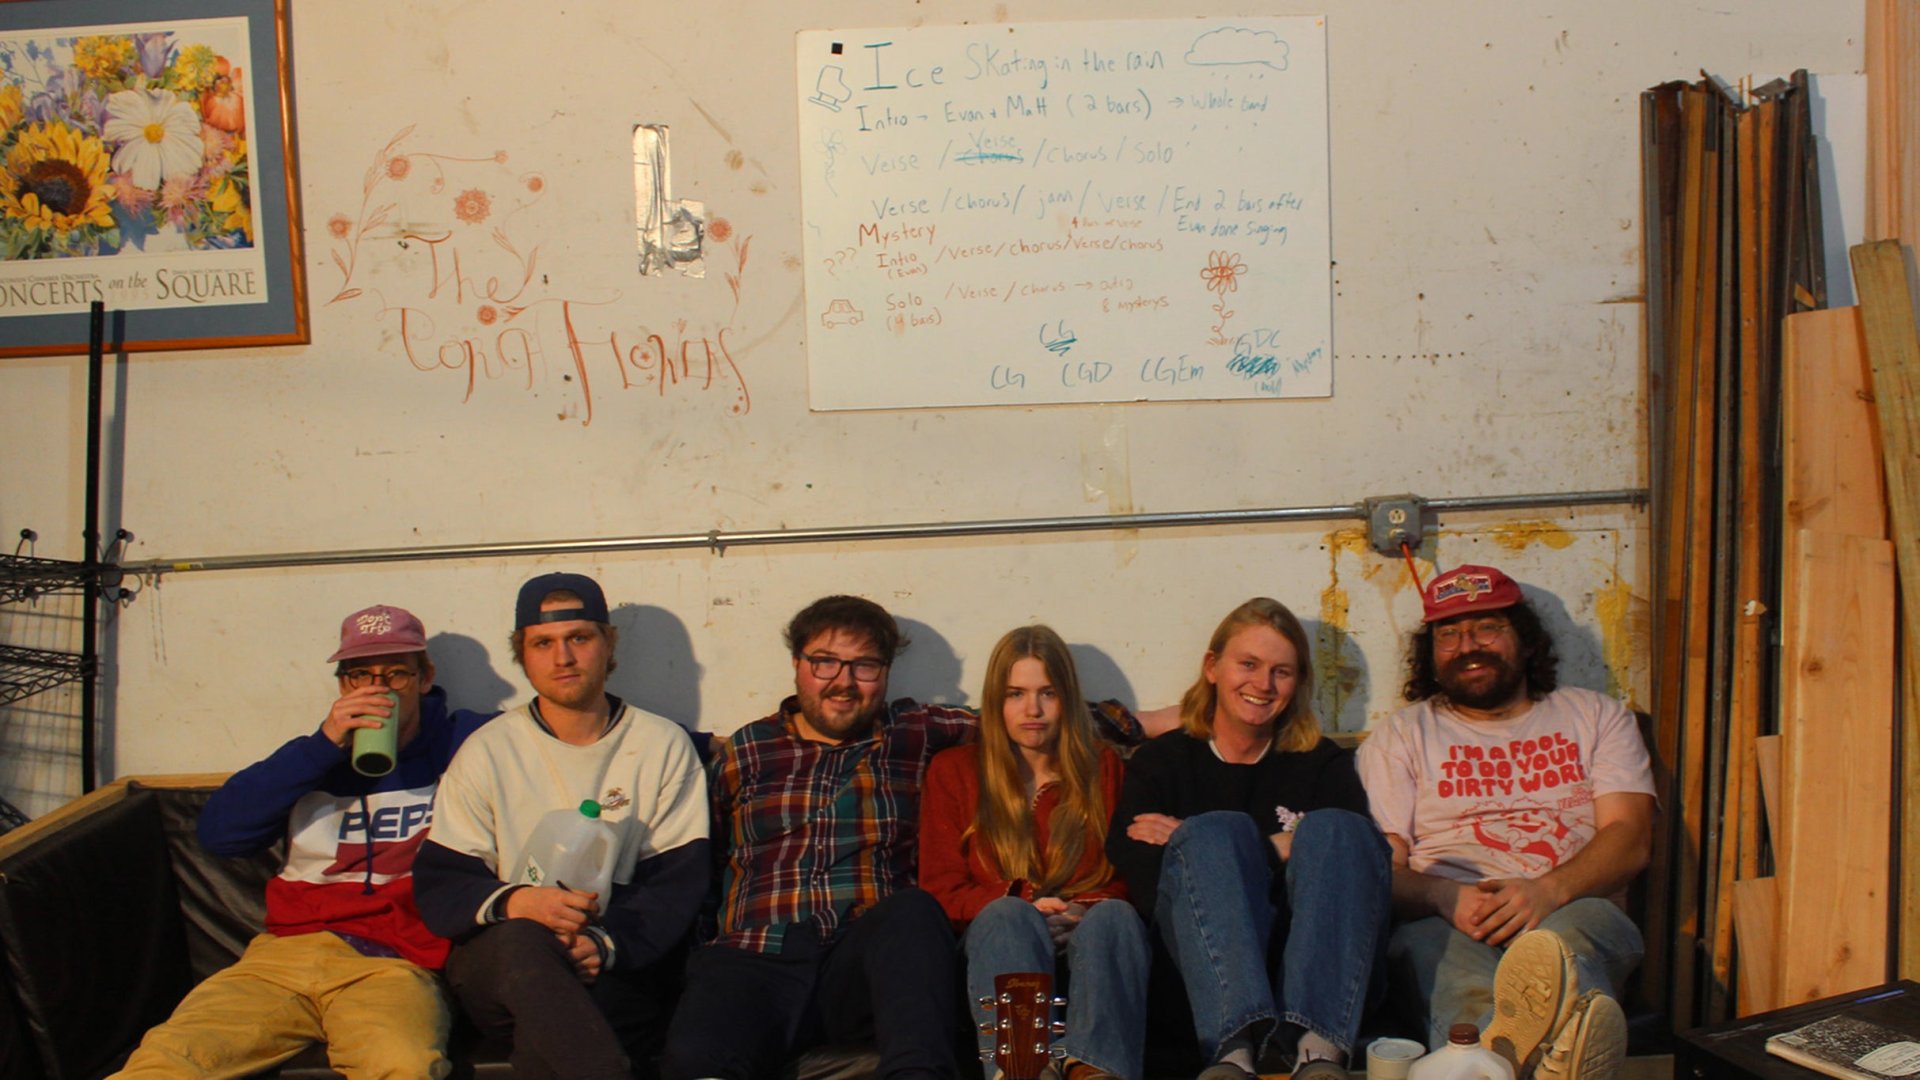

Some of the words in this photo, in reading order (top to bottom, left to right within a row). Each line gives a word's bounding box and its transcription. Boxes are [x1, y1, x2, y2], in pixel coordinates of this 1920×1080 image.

[864, 41, 944, 91] Ice
[1054, 55, 1071, 71] in
[1083, 48, 1115, 72] the
[1126, 50, 1164, 70] rain
[856, 104, 907, 132] Intro
[944, 101, 984, 123] Evan
[968, 128, 1016, 150] Verse
[861, 152, 920, 176] Verse
[1134, 141, 1173, 164] Solo
[872, 197, 930, 220] Verse
[1036, 189, 1073, 221] jam
[1173, 186, 1203, 212] End
[1268, 191, 1304, 211] after
[858, 222, 936, 249] Mystery
[1177, 214, 1206, 233] Evan
[1210, 218, 1239, 237] done
[403, 229, 530, 304] The
[876, 252, 917, 269] Intro
[948, 244, 993, 261] Verse
[108, 278, 124, 290] on
[128, 271, 148, 289] the
[156, 268, 256, 303] SQUARE
[886, 292, 923, 311] Solo
[958, 285, 998, 299] Verse
[991, 364, 1025, 390] CG
[1062, 361, 1113, 388] CGD
[1441, 760, 1473, 779] TO
[1478, 760, 1512, 779] DO
[1516, 742, 1580, 774] YOUR
[1449, 744, 1484, 761] I'M
[1489, 746, 1506, 760] A
[1509, 732, 1568, 760] FOOL
[1438, 778, 1514, 798] DIRTY
